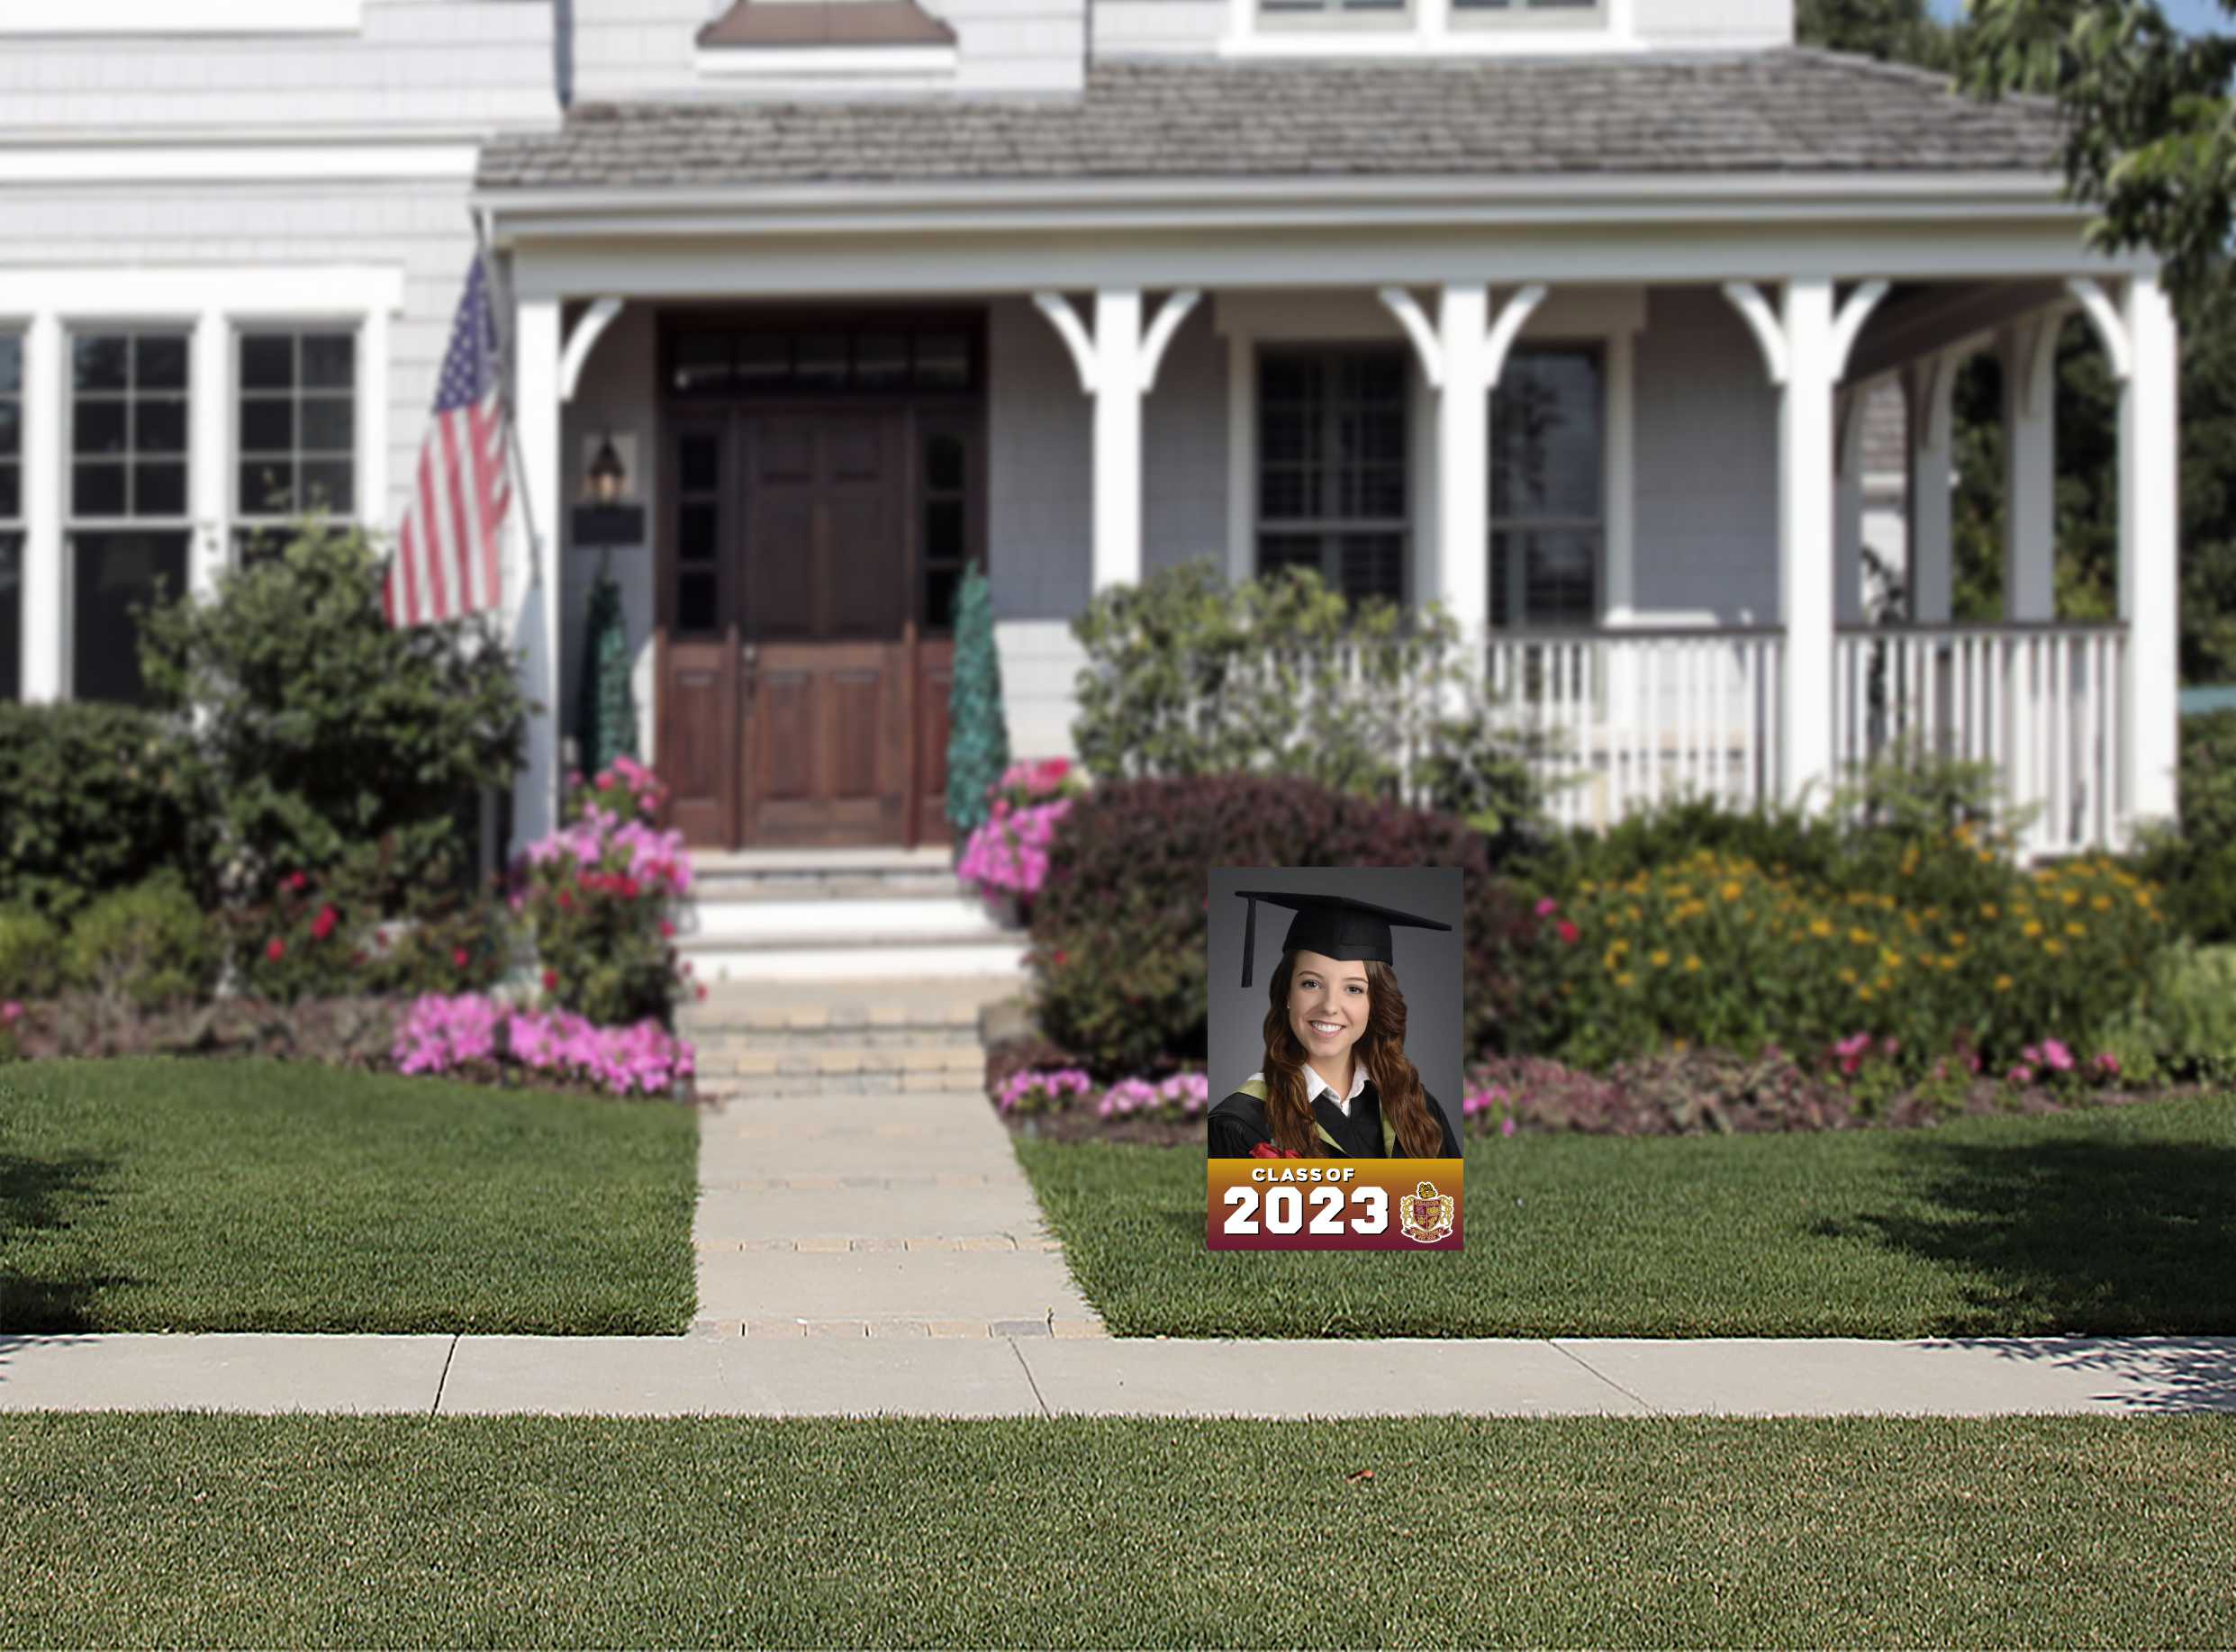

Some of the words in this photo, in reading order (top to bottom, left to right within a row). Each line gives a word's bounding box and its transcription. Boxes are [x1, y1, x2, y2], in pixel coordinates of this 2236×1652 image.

[1252, 1168, 1322, 1181] CLASS
[1326, 1168, 1354, 1181] OF
[1224, 1187, 1390, 1234] 2023
